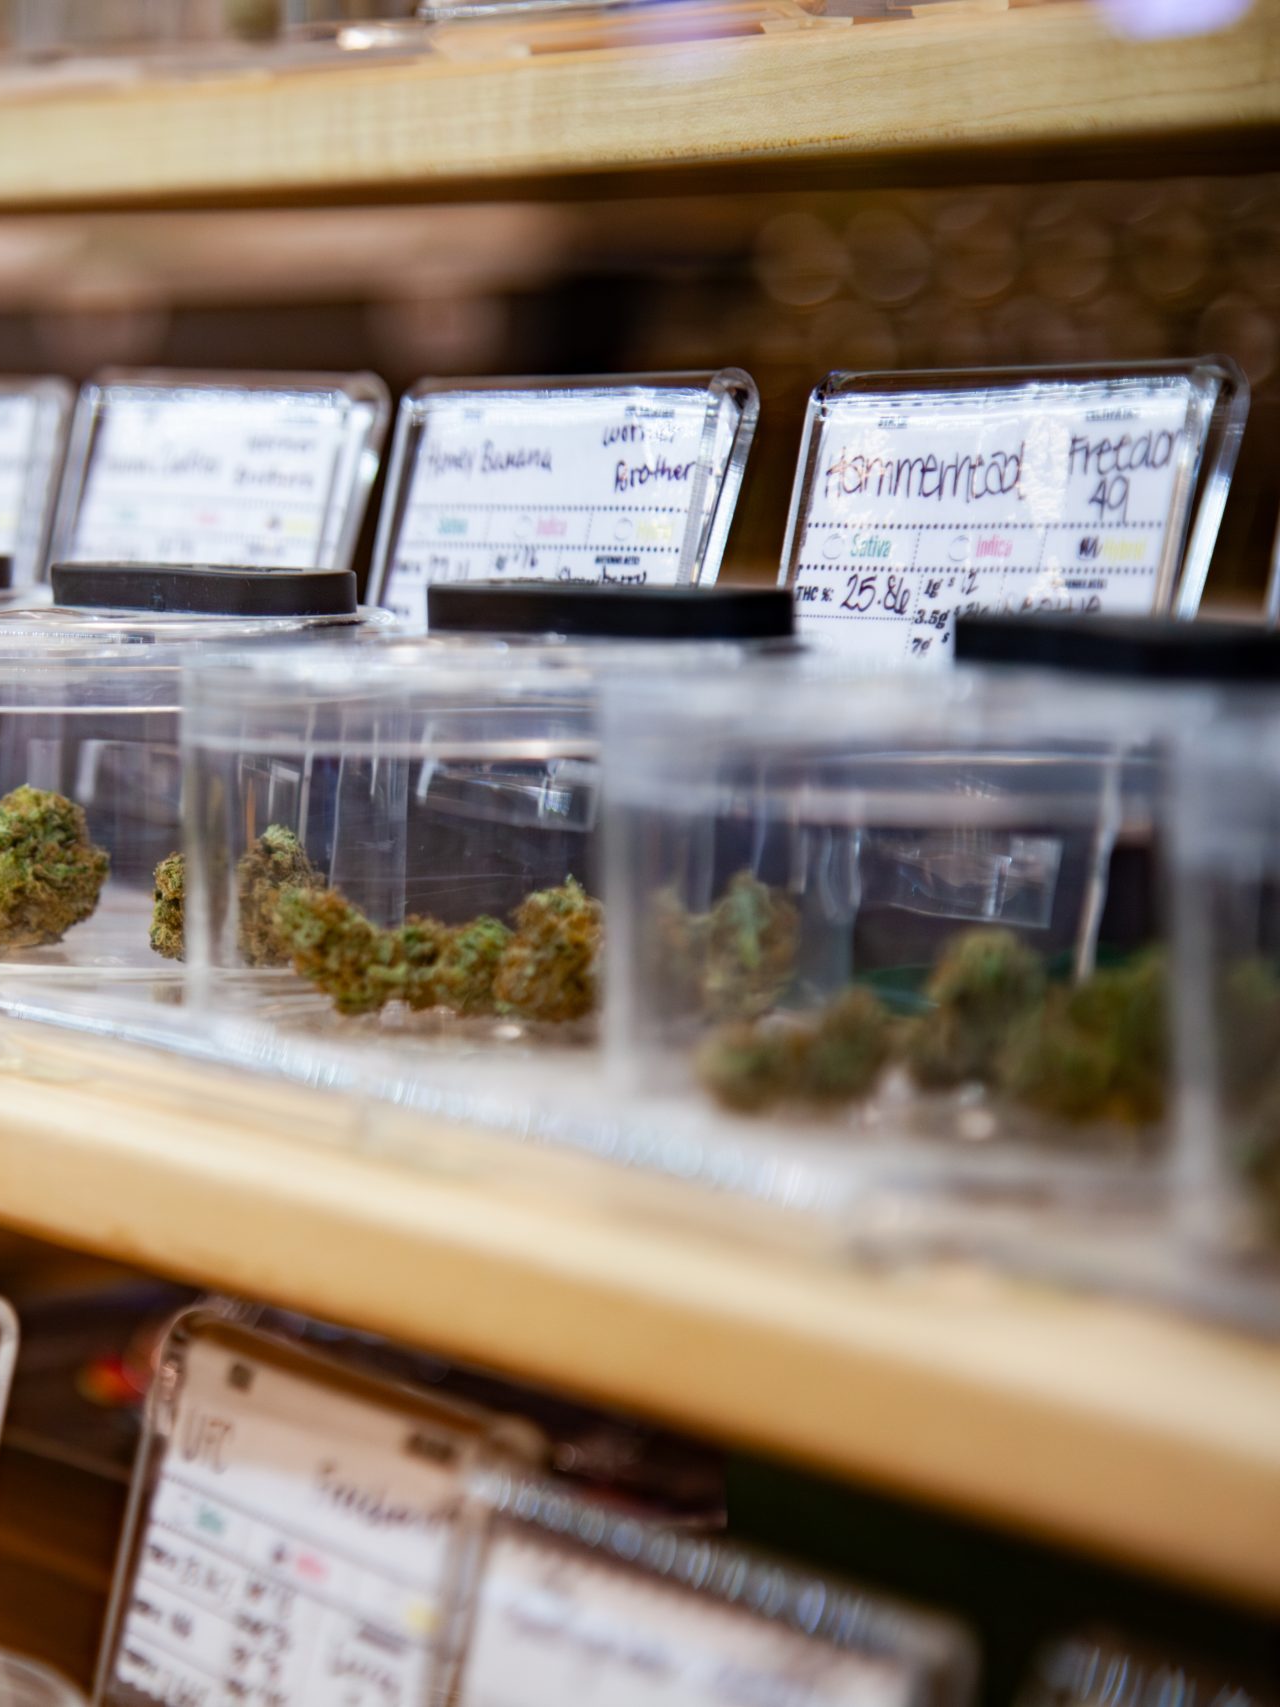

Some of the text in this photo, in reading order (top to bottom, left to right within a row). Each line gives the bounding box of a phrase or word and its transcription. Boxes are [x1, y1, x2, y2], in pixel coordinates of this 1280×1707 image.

[850, 532, 893, 558] Sativa
[797, 585, 819, 602] THC
[914, 607, 950, 630] 3.5g
